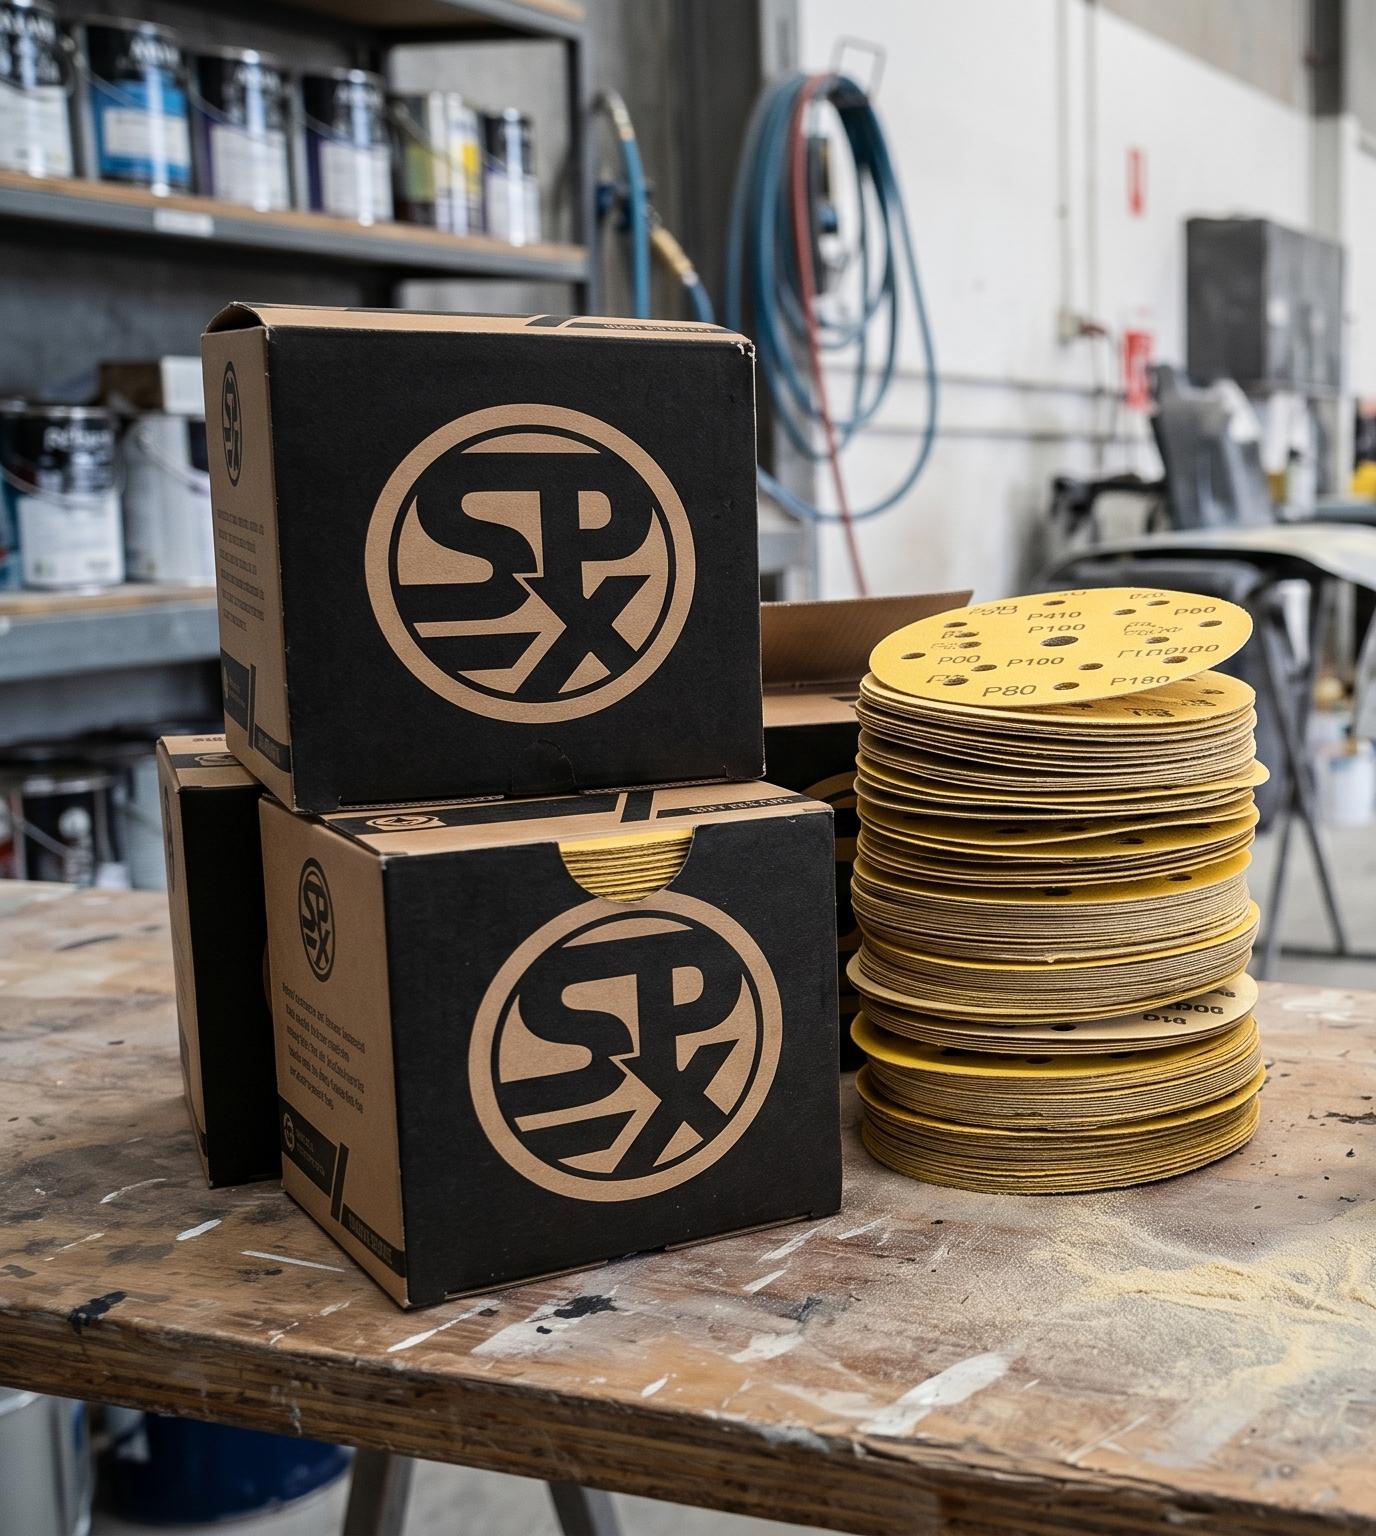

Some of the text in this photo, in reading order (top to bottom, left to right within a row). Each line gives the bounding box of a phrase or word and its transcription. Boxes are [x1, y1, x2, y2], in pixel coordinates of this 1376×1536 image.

[1027, 611, 1082, 621] P410
[1028, 623, 1086, 634] P100
[1006, 656, 1065, 668] P100
[1110, 675, 1170, 686] P180
[982, 684, 1037, 698] P80
